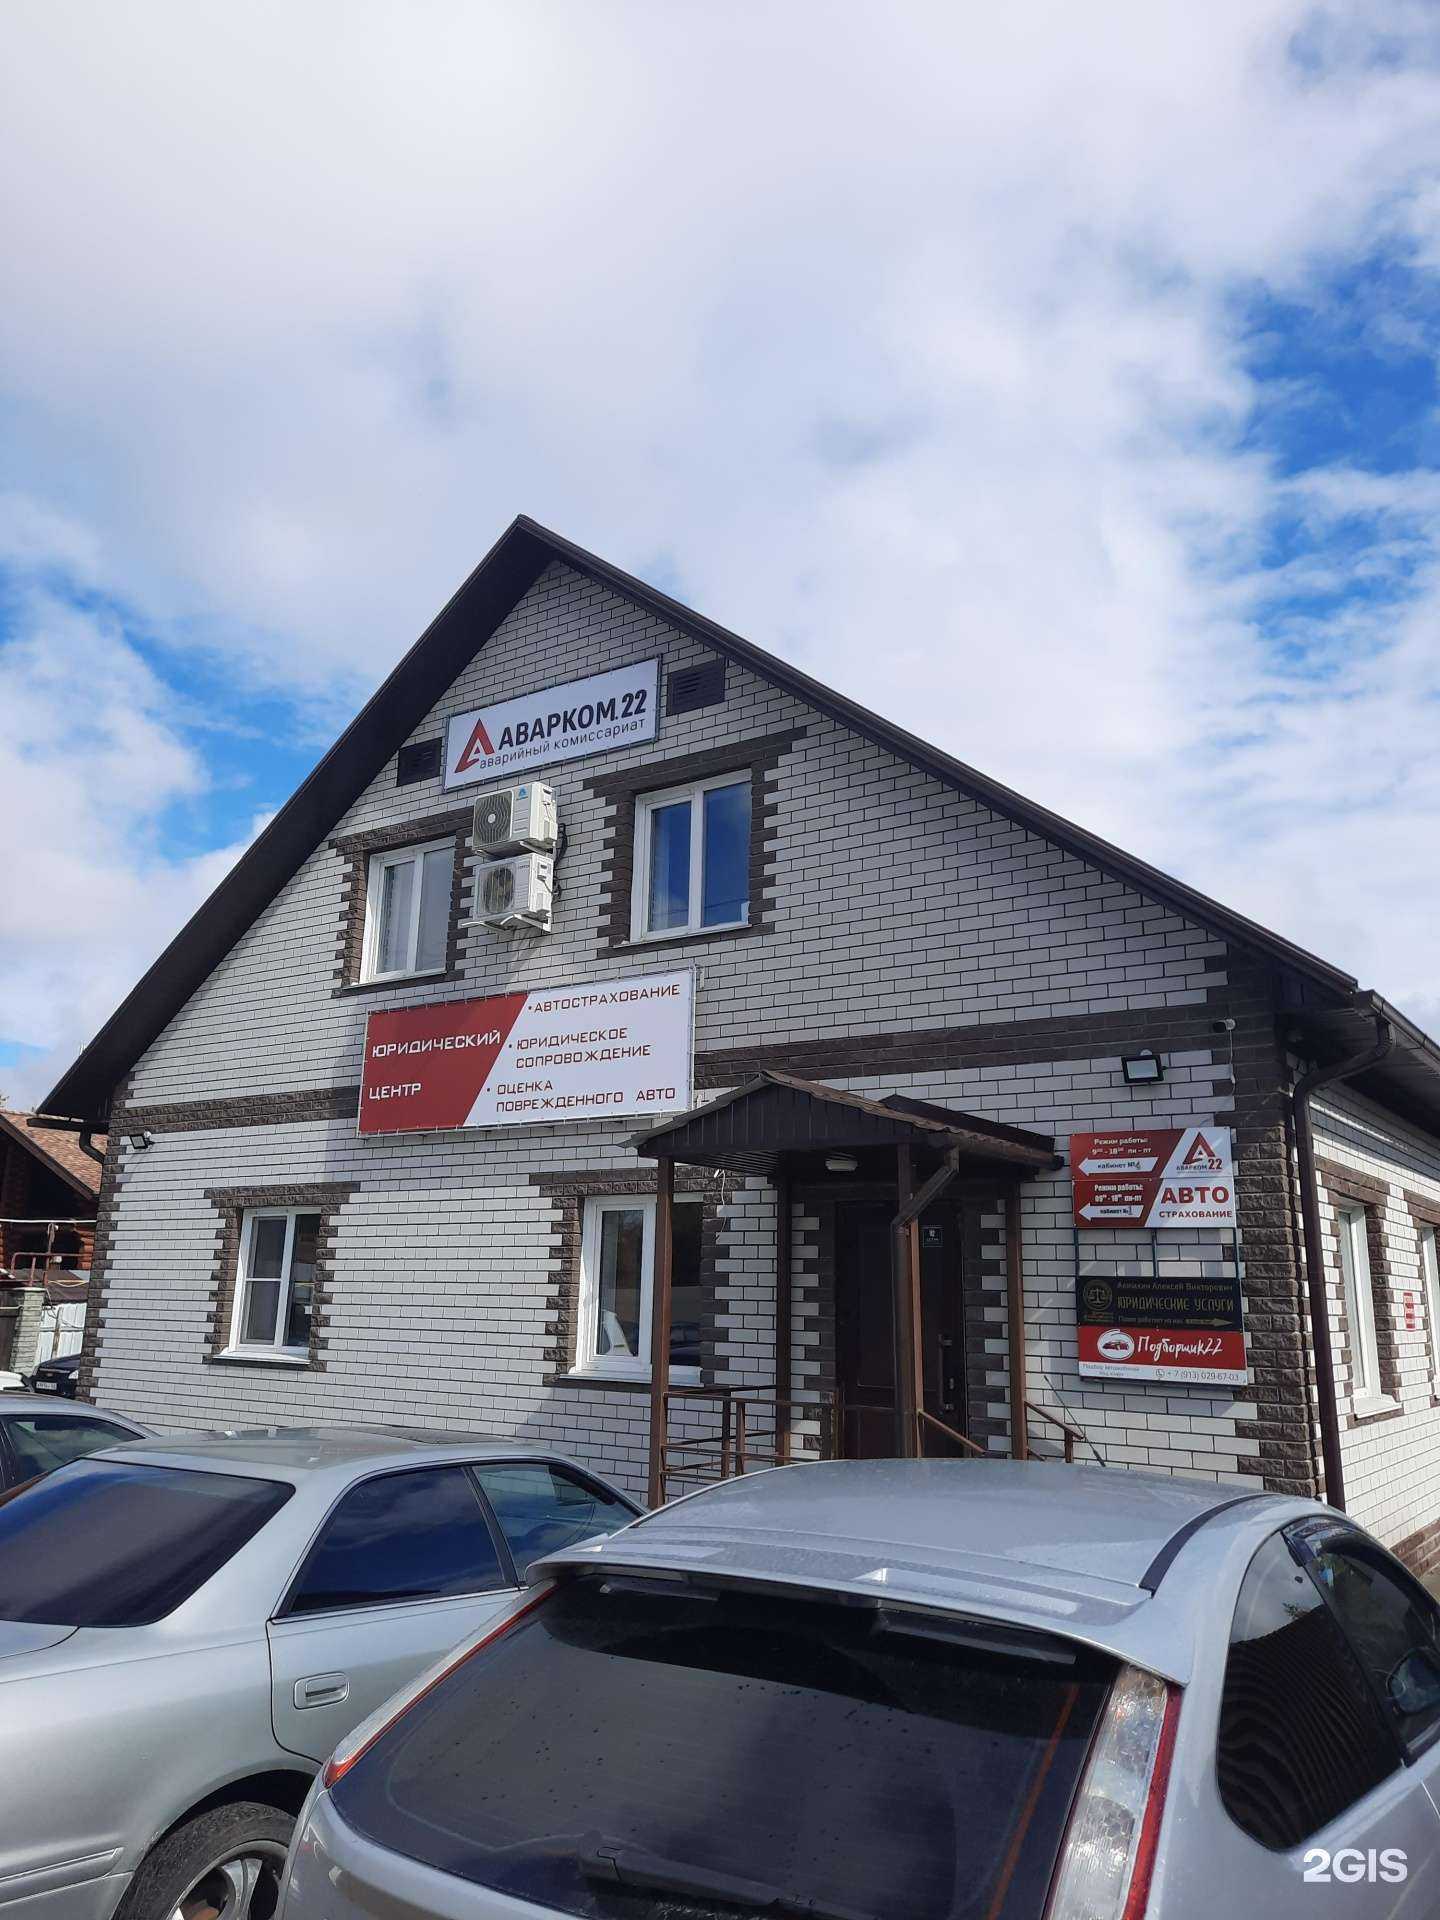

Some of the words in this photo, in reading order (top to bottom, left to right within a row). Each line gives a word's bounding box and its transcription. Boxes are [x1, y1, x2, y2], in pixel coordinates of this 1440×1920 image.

[498, 689, 647, 751] АВАРКОМ.22
[480, 741, 550, 770] аварийный
[553, 718, 646, 750] комиссариат
[533, 984, 681, 1014] АВТОСТРАХОВАНИЕ
[371, 1029, 501, 1058] ЮРИДИЧЕСКИЙ
[516, 1027, 628, 1051] ЮРИДИЧЕСКОЕ
[515, 1045, 652, 1069] СОПРОВОЖДЕНИЕ
[368, 1082, 422, 1101] ЦЕНТР
[496, 1080, 553, 1096] ОЦЕНКА
[496, 1091, 624, 1113] ПОВРЕЖДЕННОГО
[635, 1087, 676, 1102] АВТО
[1160, 1186, 1230, 1205] АВТО
[1158, 1210, 1233, 1219] СТРАХОВАНИЕ
[1117, 1295, 1190, 1312] ЮРИДИЧЕСКИЕ
[1194, 1299, 1234, 1313] УСЛУГИ
[1137, 1335, 1224, 1362] Подборщик22
